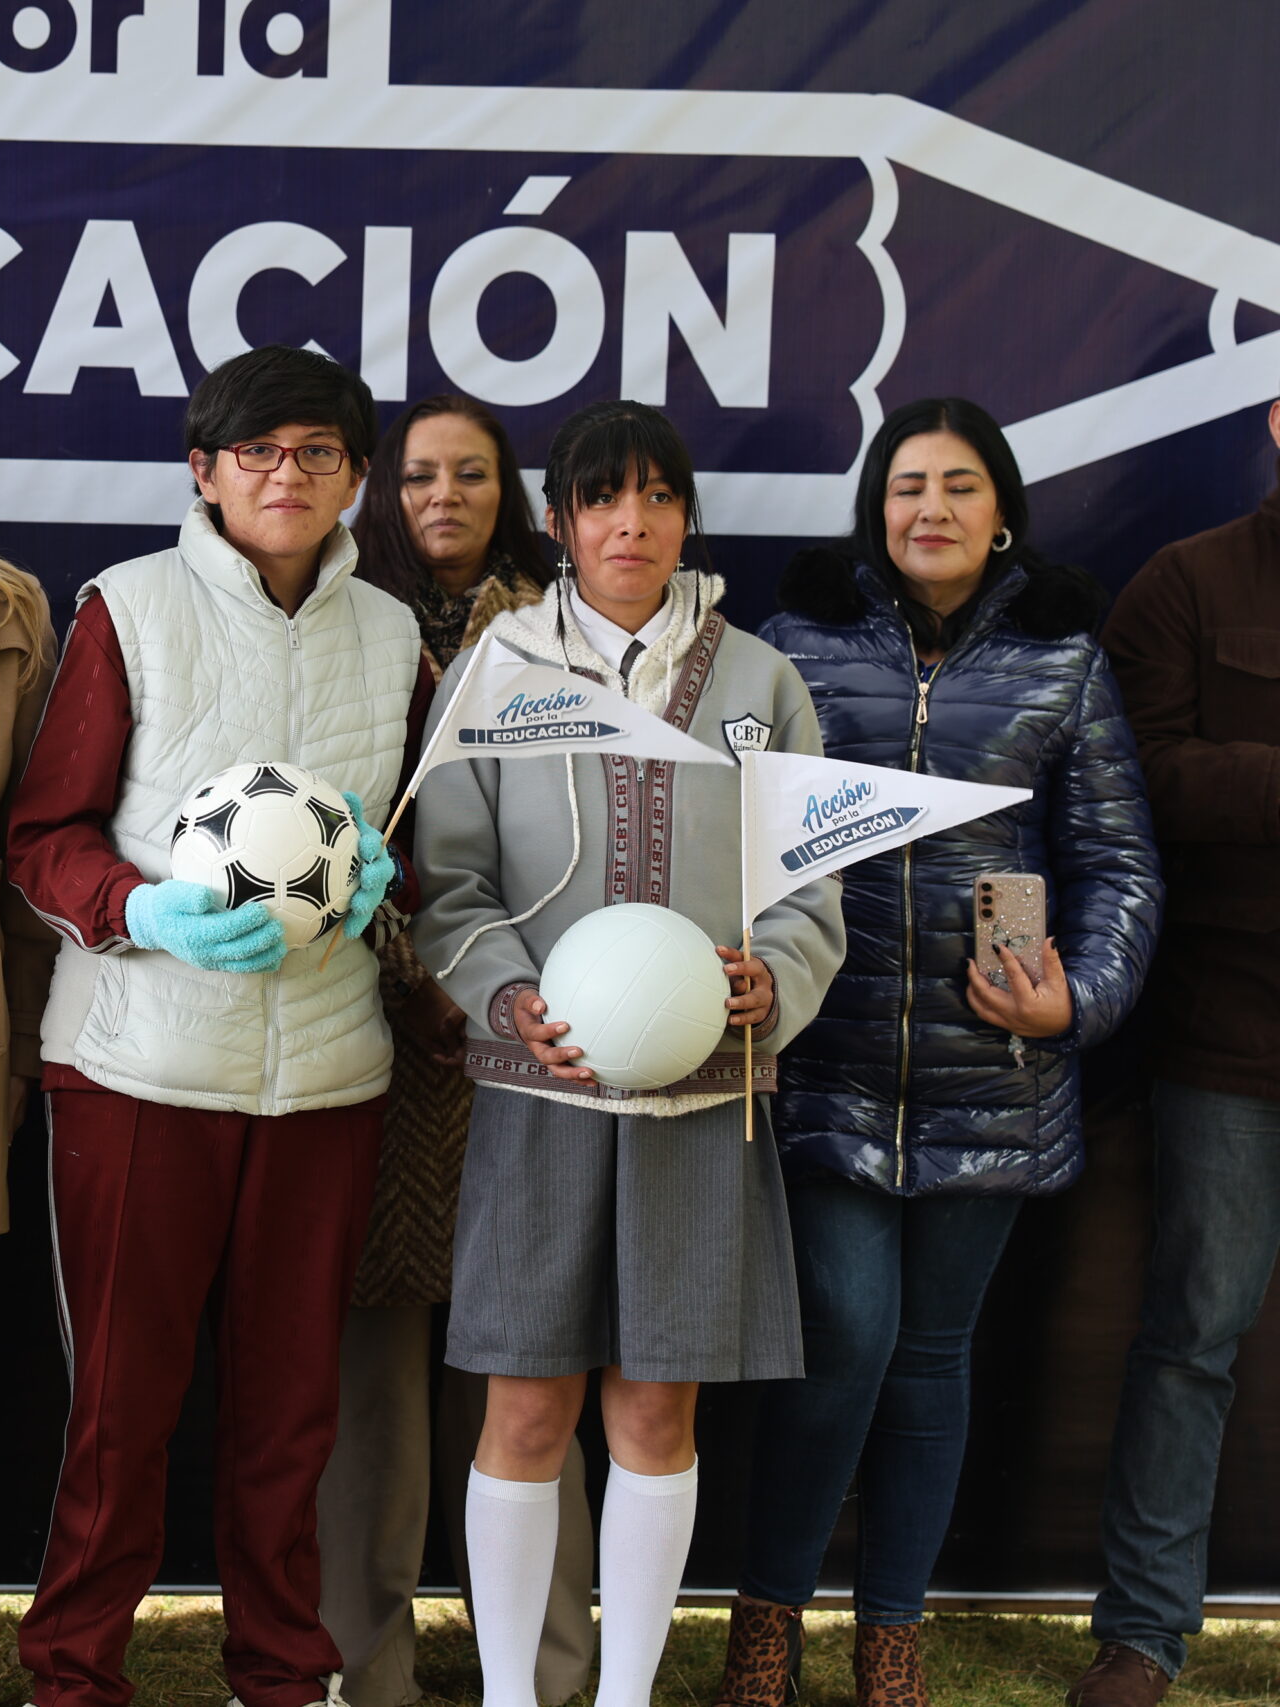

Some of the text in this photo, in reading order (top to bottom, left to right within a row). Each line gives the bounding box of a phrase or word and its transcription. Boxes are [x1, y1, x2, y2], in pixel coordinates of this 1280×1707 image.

[704, 619, 718, 644] CBT
[694, 645, 710, 678] CBT
[496, 688, 587, 726] Acción
[680, 680, 698, 713] CBT
[493, 722, 590, 742] EDUCACIÓN
[526, 715, 545, 724] por
[733, 724, 764, 744] CBT
[615, 773, 627, 809] CBT
[802, 779, 871, 834] Acción
[653, 797, 665, 833] CBT
[831, 809, 860, 827] por la
[616, 815, 628, 852] CBT
[811, 813, 897, 856] EDUCACIÓN
[651, 838, 663, 875] CBT
[614, 858, 626, 895] CBT
[650, 880, 662, 905] CB
[469, 1054, 549, 1075] CBT CBT CB
[697, 1068, 726, 1079] CBT
